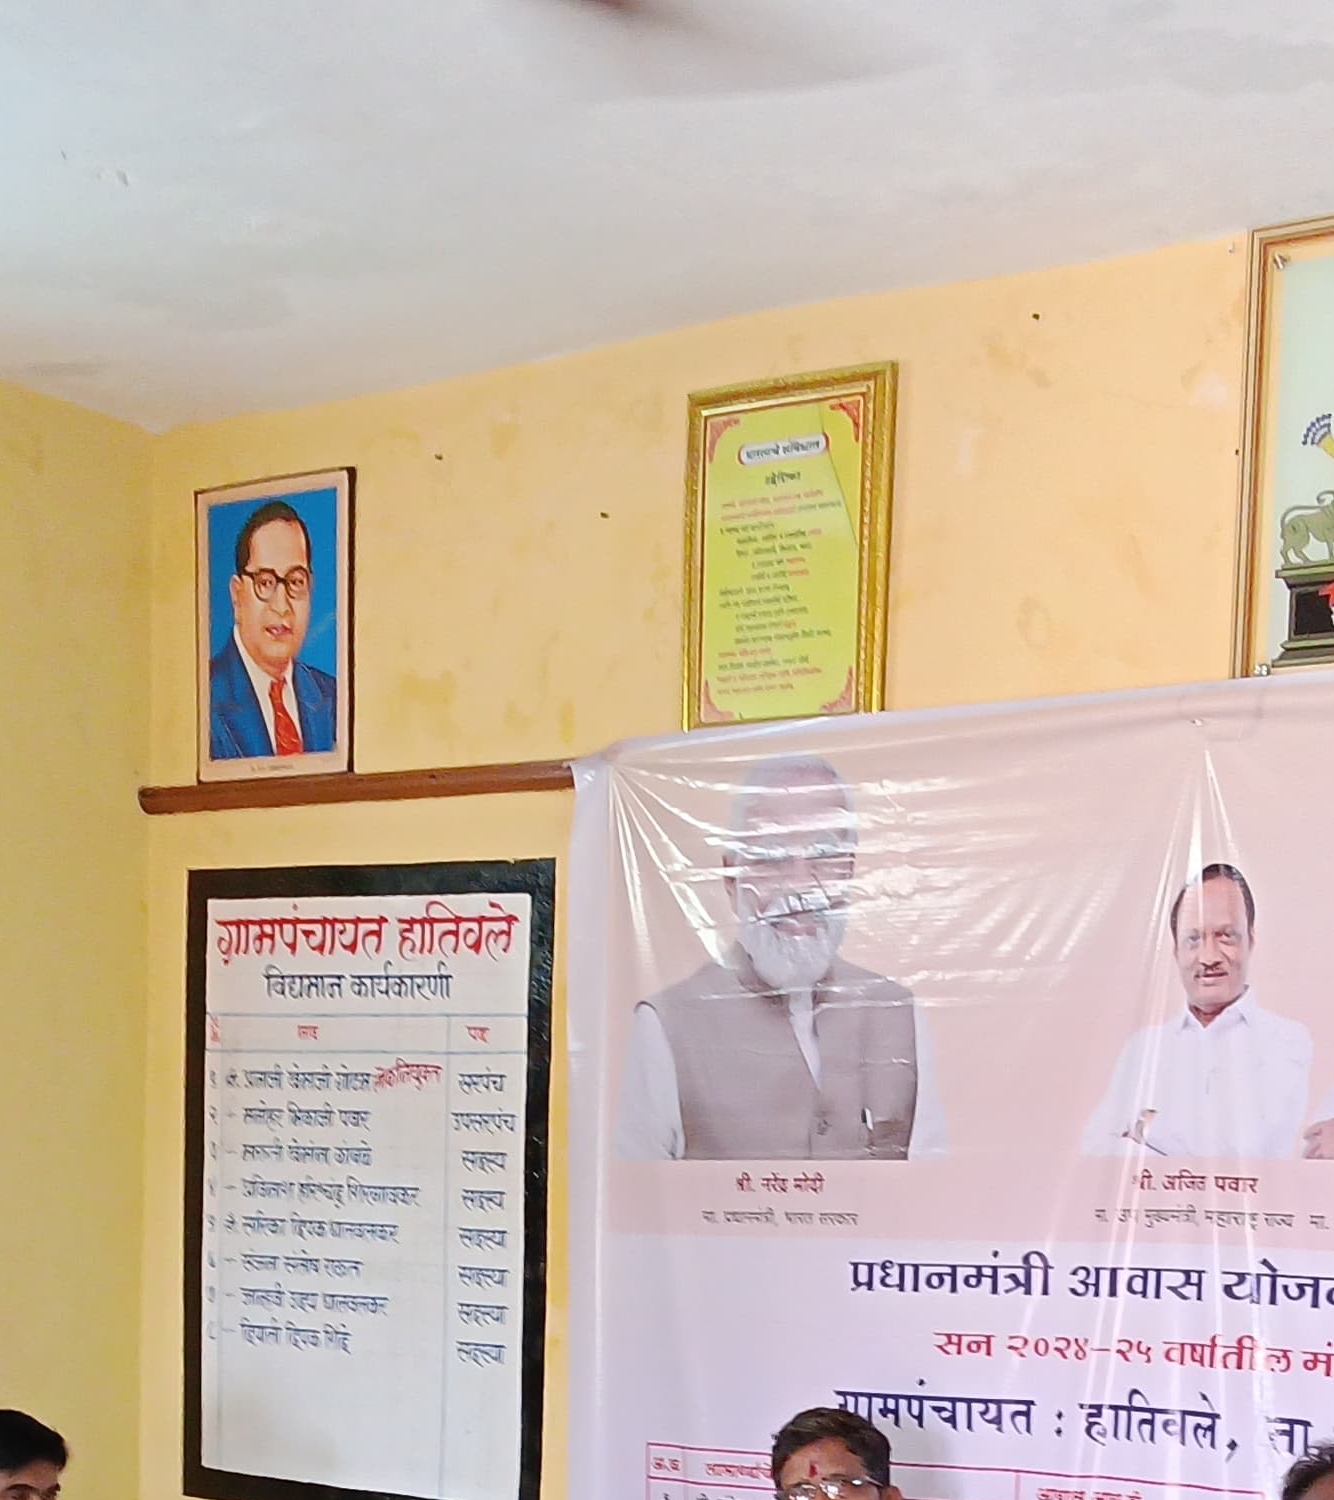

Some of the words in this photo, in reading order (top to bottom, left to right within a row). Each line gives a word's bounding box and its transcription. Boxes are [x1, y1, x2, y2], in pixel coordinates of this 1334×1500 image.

[215, 903, 389, 965] ग्रामपंचायत
[397, 900, 520, 961] हातिवले
[263, 963, 345, 1000] विद्यमान
[350, 960, 453, 1001] कार्यकारणी
[849, 1249, 1055, 1297] प्रधानमंत्री
[1067, 1265, 1208, 1301] आवास
[933, 1330, 996, 1358] सन
[1161, 1333, 1294, 1374] वर्षातील
[1079, 1388, 1240, 1463] हातिवले,
